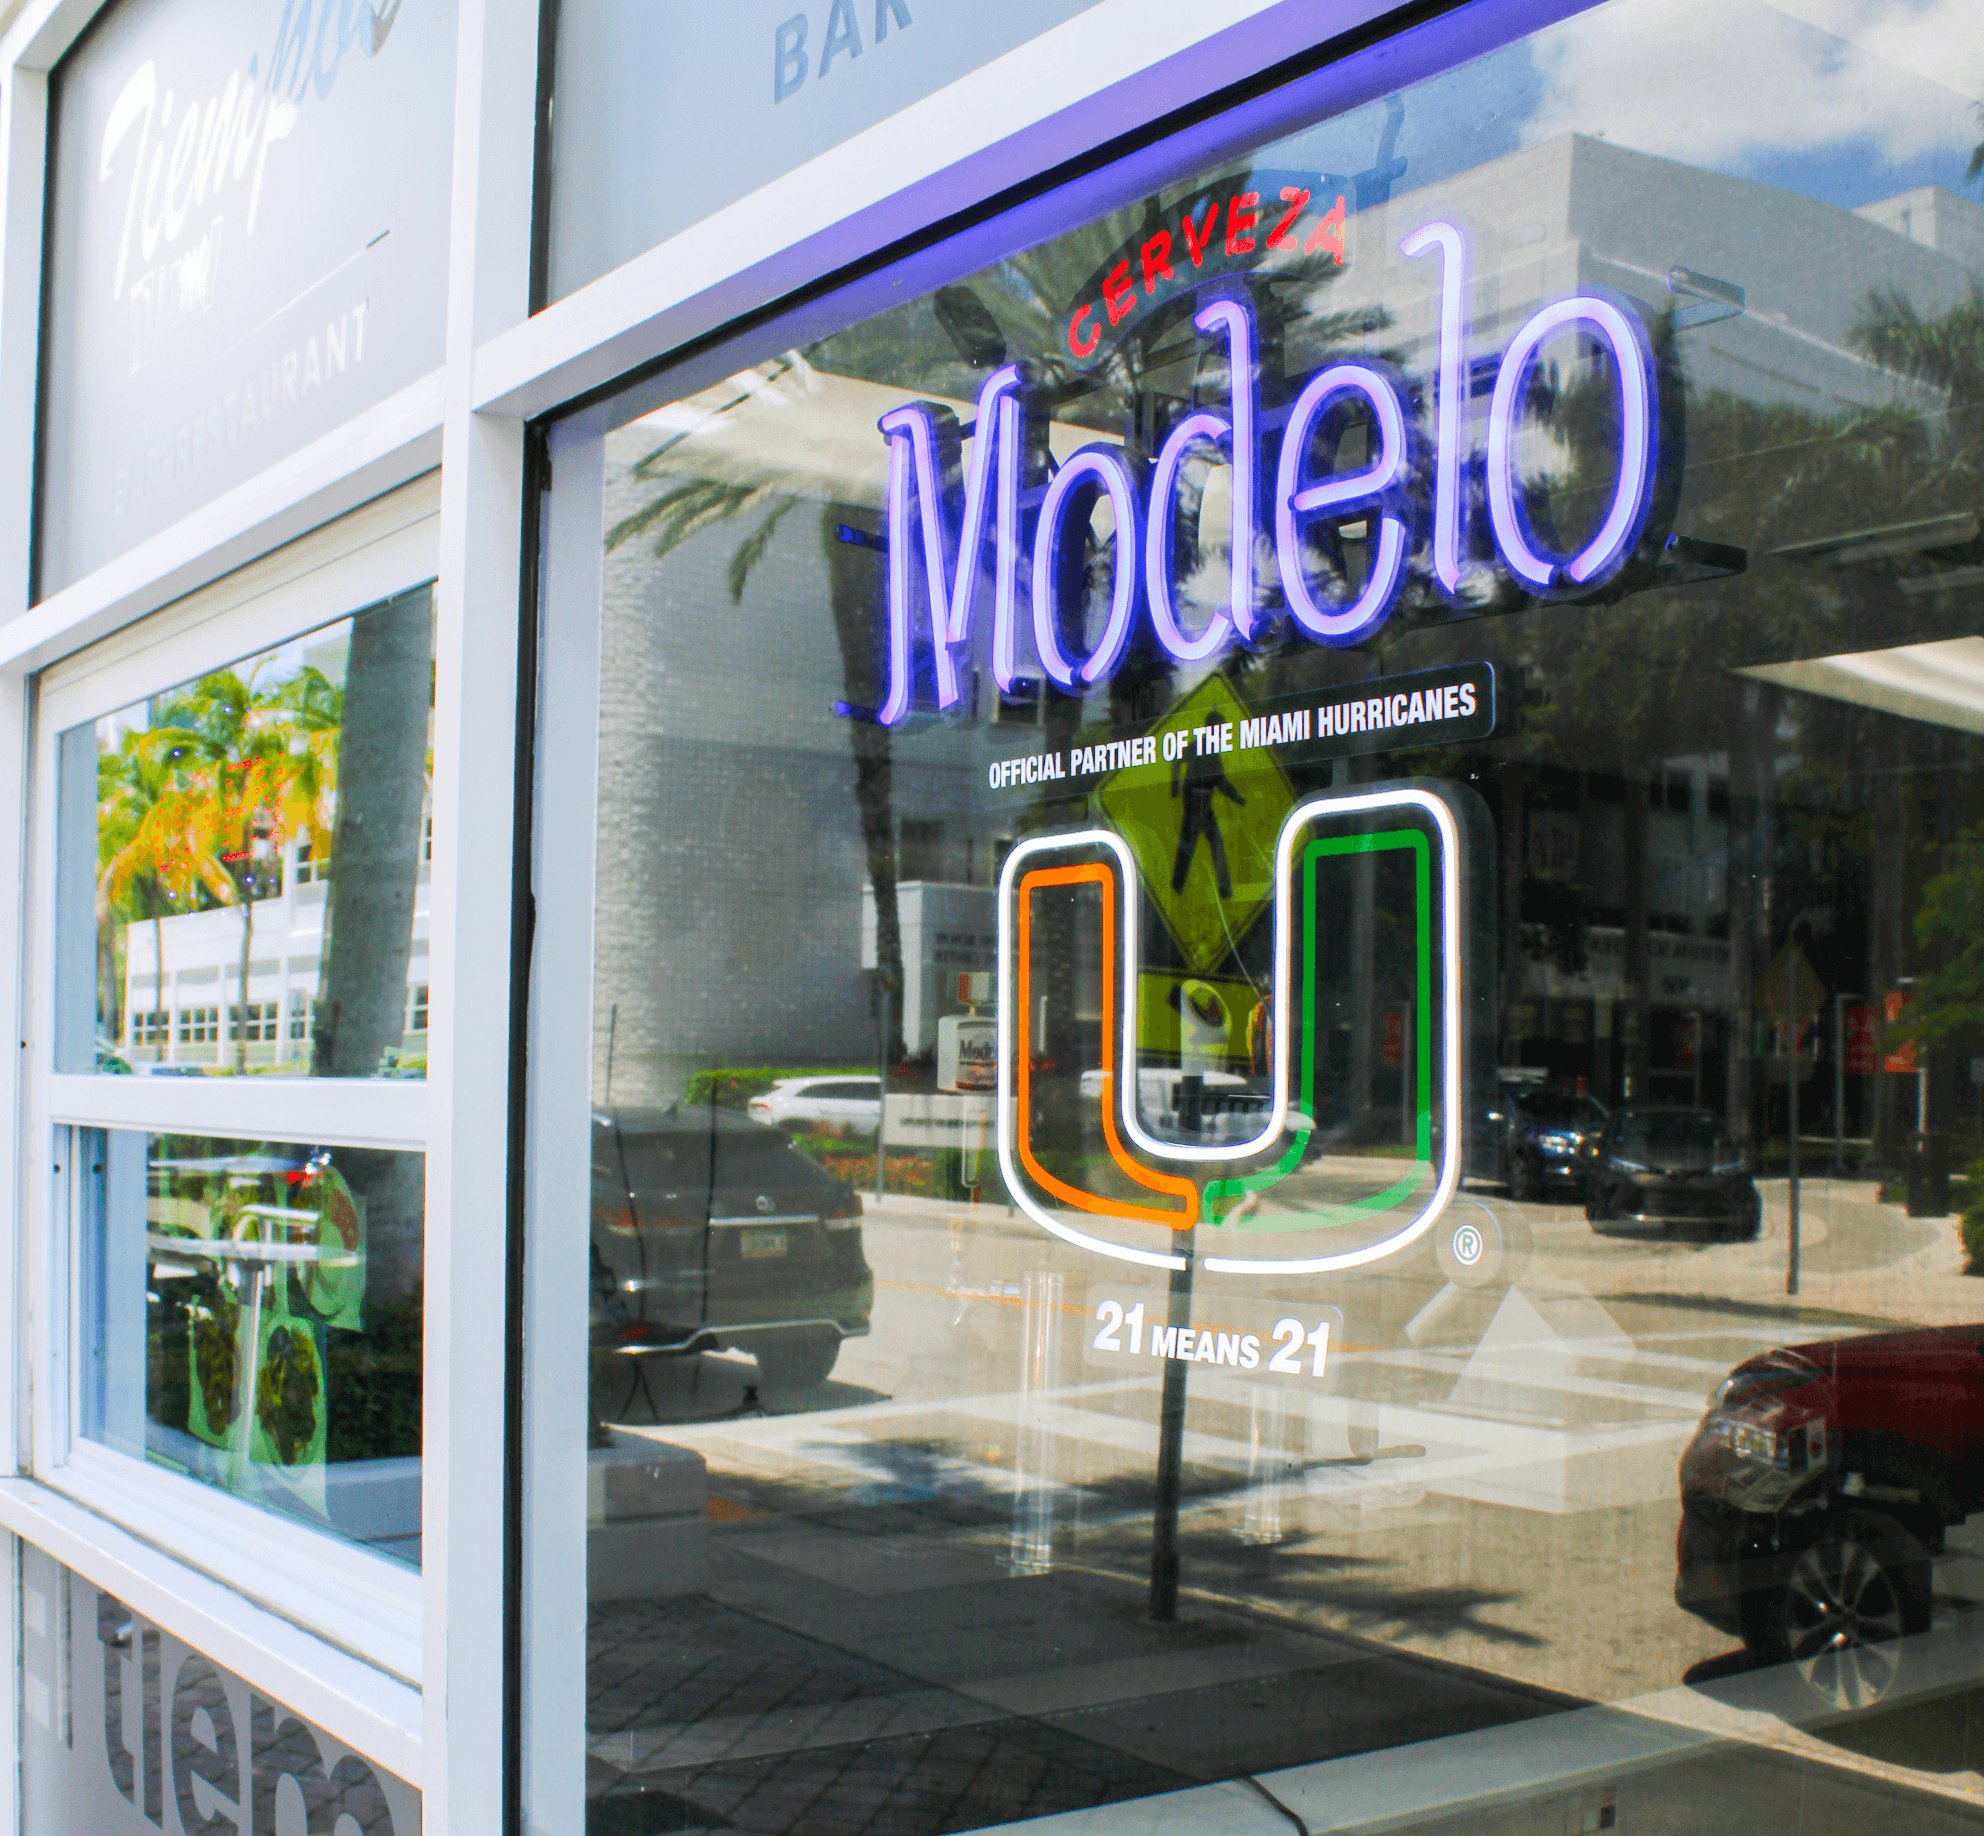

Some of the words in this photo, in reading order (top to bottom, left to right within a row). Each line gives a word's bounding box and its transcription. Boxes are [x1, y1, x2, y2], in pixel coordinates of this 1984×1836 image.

[1068, 187, 1346, 359] CERVEZA
[877, 221, 1652, 727] Modelo
[988, 753, 1066, 790] OFFICIAL
[1070, 735, 1157, 778] PARTNER
[1162, 730, 1190, 762] OF
[1193, 722, 1234, 757] THE
[1239, 710, 1311, 750] MIAMI
[1317, 683, 1478, 738] HURRICANES
[1092, 1298, 1145, 1355] 21
[1151, 1325, 1261, 1369] MEANS
[1268, 1317, 1331, 1379] 21
